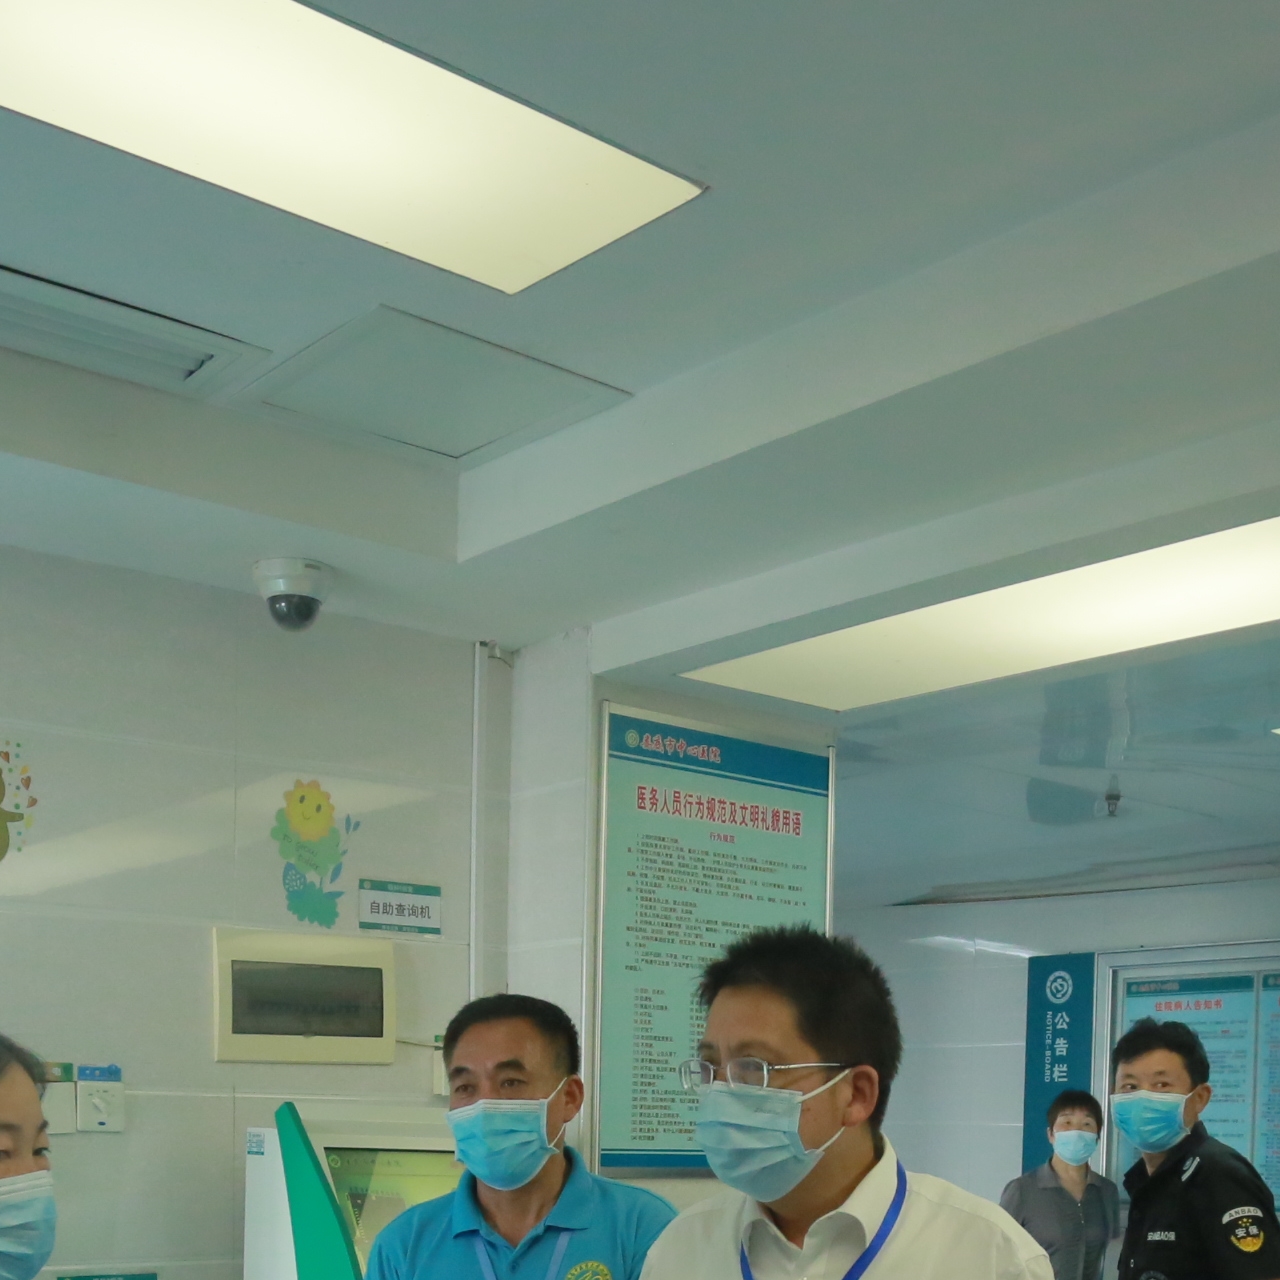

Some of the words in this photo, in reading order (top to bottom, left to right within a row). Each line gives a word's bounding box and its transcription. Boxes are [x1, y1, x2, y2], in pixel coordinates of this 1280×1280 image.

[640, 733, 721, 763] 娄底市中心医院
[636, 785, 802, 836] 医务人员行为规范及文明礼貌用语
[370, 900, 431, 919] 自助查询机
[1154, 999, 1223, 1012] 住院病人告知书
[1045, 1011, 1053, 1082] NOTICE-BOARD
[1053, 1012, 1070, 1082] 公告栏
[1227, 1208, 1260, 1220] ANBAO
[1234, 1225, 1260, 1238] 安保
